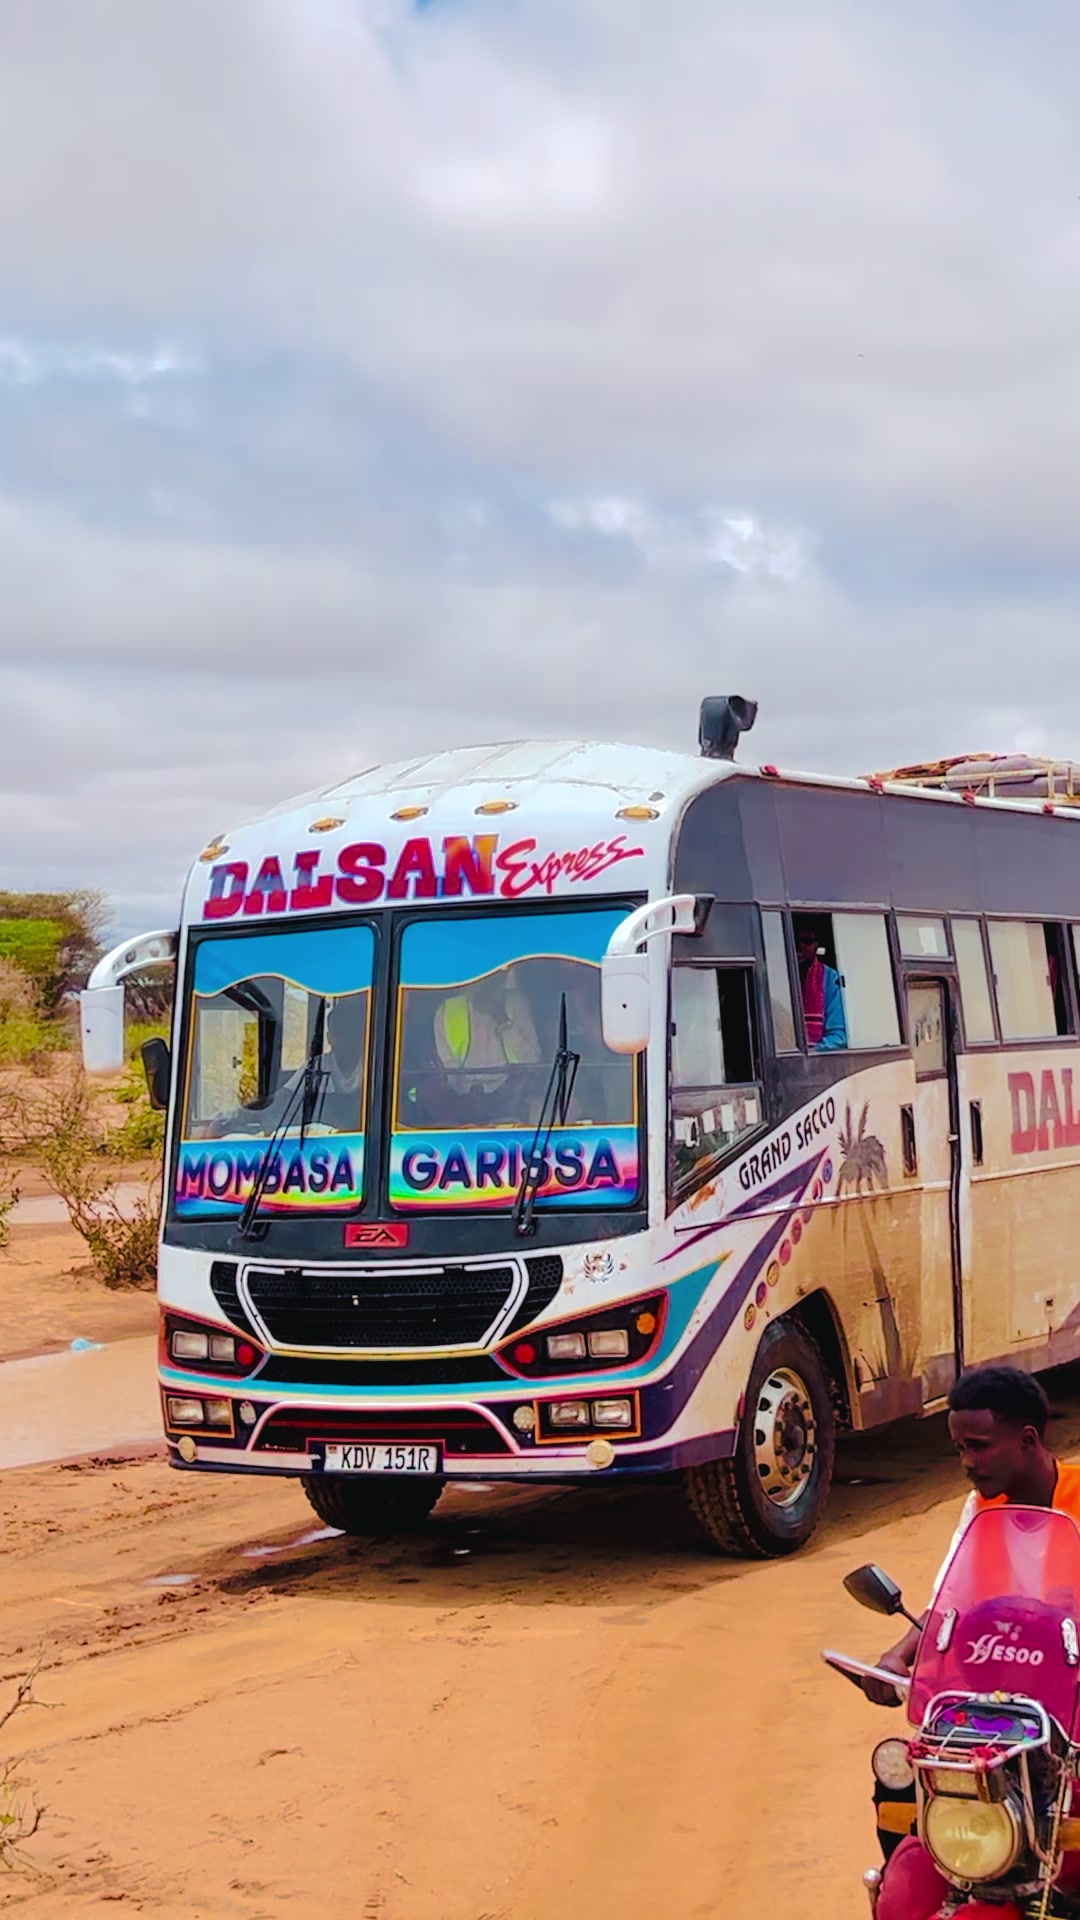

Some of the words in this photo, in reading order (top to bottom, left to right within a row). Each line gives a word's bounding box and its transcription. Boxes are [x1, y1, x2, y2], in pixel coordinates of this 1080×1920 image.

[203, 833, 498, 920] DALSAN
[496, 835, 645, 898] Express
[401, 1137, 624, 1192] GARISSA
[739, 1132, 791, 1190] GRAND
[796, 1097, 835, 1150] SACCO
[182, 1146, 354, 1196] MOMBASA
[353, 1228, 397, 1243] EA
[341, 1446, 376, 1469] KDV
[384, 1447, 429, 1471] 151R
